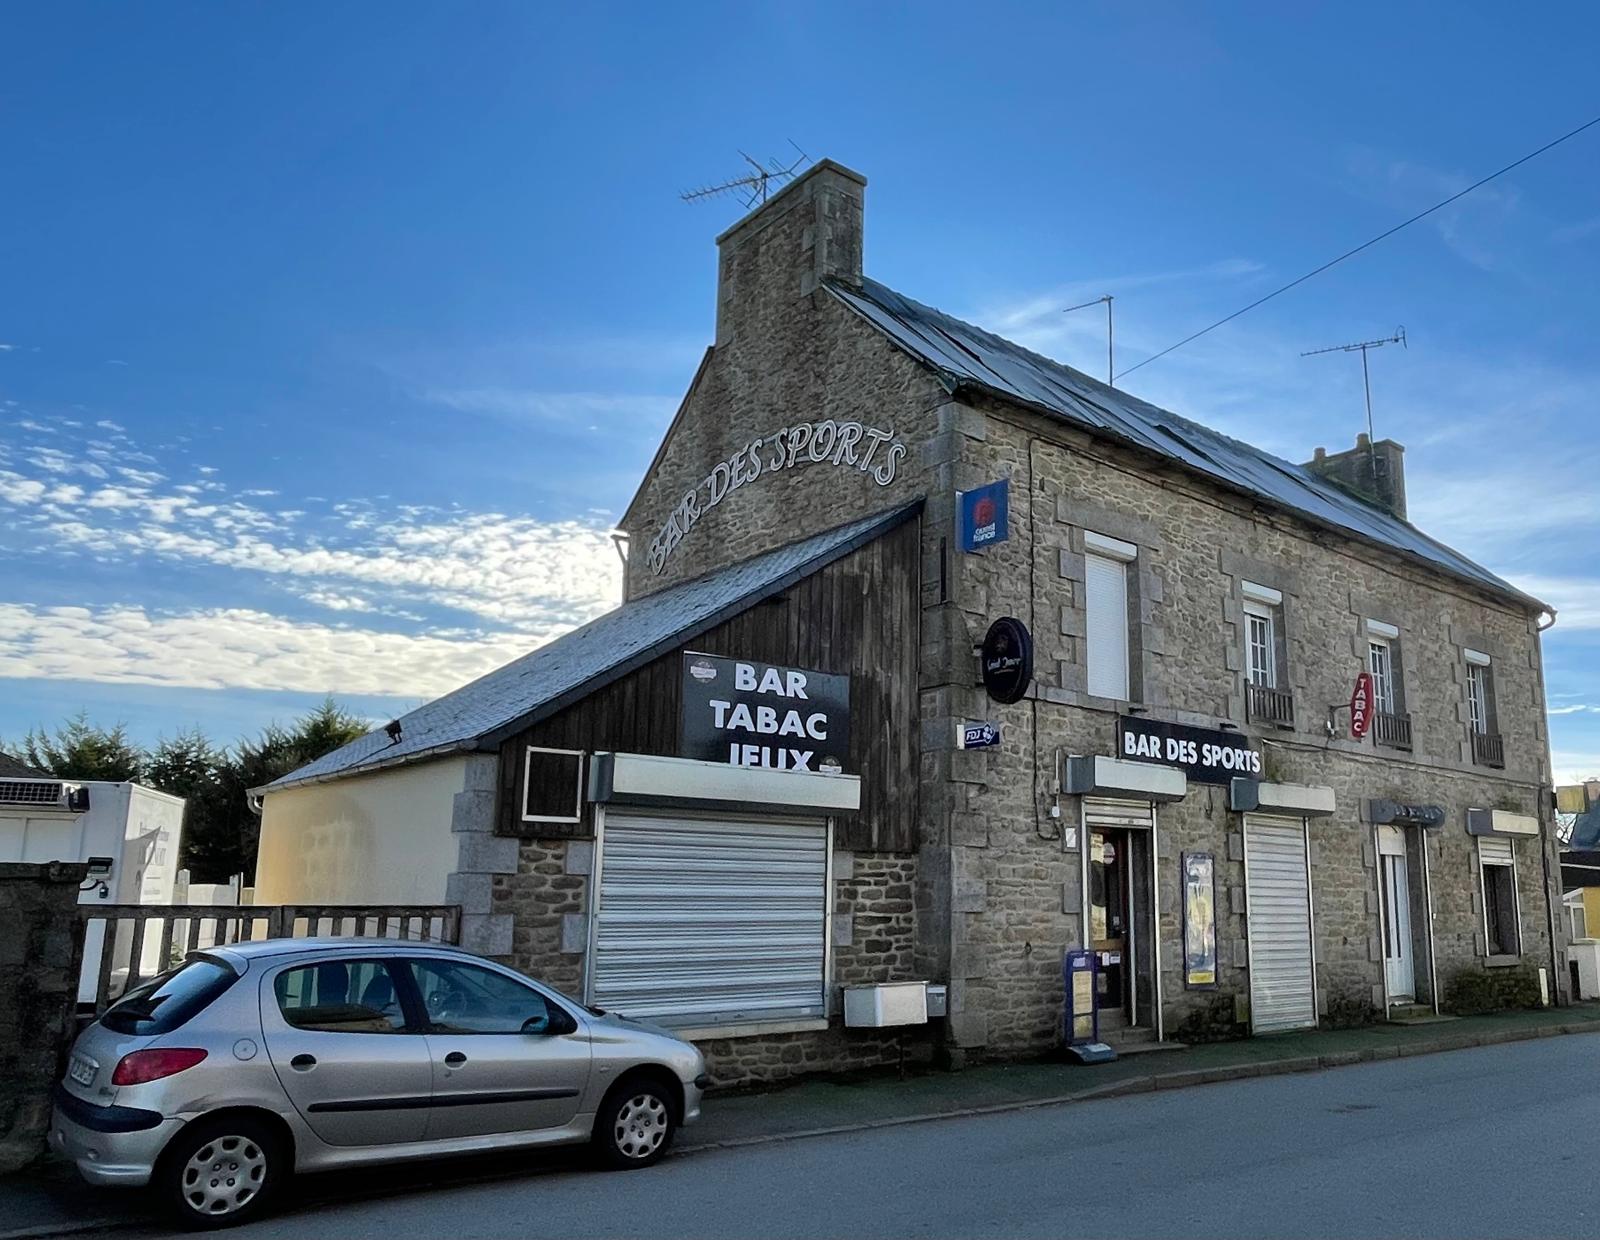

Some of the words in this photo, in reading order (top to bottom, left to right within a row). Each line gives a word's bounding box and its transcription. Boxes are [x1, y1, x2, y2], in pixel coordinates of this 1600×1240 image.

[649, 489, 702, 576] BAR
[705, 438, 764, 507] DES
[769, 419, 907, 487] SPORTS
[735, 662, 809, 700] BAR
[709, 699, 828, 741] TABAC
[1353, 678, 1367, 732] TABAC
[966, 730, 981, 741] FDJ
[1124, 731, 1162, 759] BAR
[1166, 738, 1198, 765] DES
[1202, 743, 1261, 774] SPORTS
